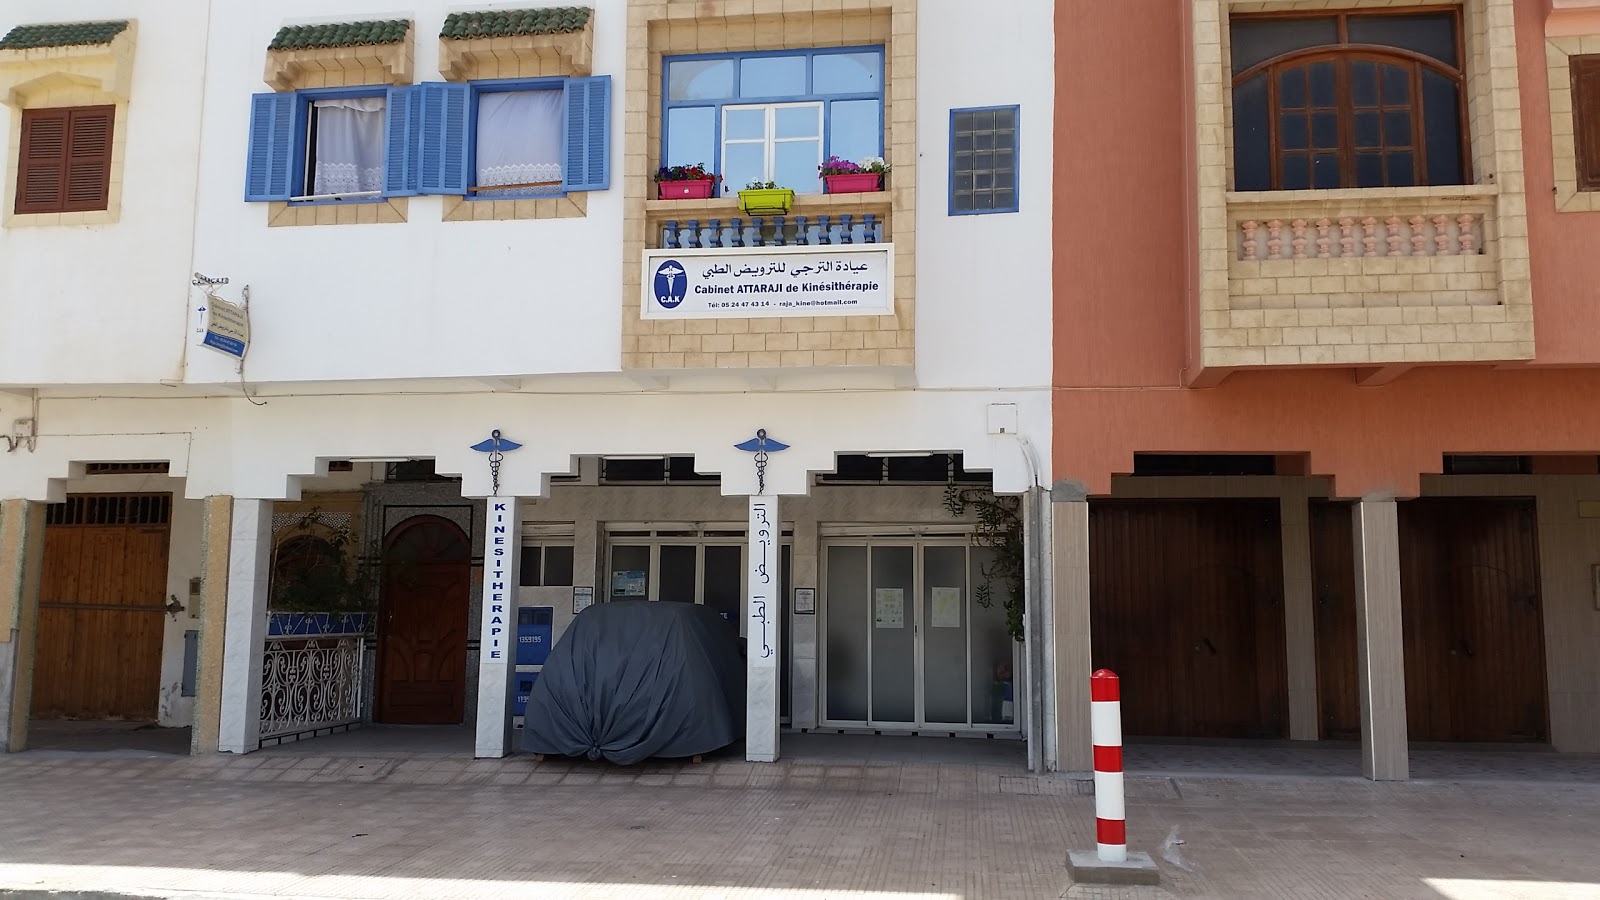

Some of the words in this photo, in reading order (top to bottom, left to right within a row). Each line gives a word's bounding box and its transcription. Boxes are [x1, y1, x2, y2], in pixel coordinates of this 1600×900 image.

[702, 263, 732, 280] الطبي
[733, 262, 786, 278] للترويض
[790, 260, 833, 278] الترجي
[835, 260, 868, 275] عيادة
[694, 284, 734, 294] Cabinet
[736, 283, 783, 294] ATTARAJI
[786, 283, 799, 292] de
[802, 280, 879, 292] Kinésithérapie
[660, 295, 680, 303] C.A.K
[779, 299, 858, 308] raja_kine@hotmail.com
[753, 503, 770, 584] الترويض
[490, 503, 506, 659] KINESITHERAPIE
[752, 596, 774, 659] الطبي
